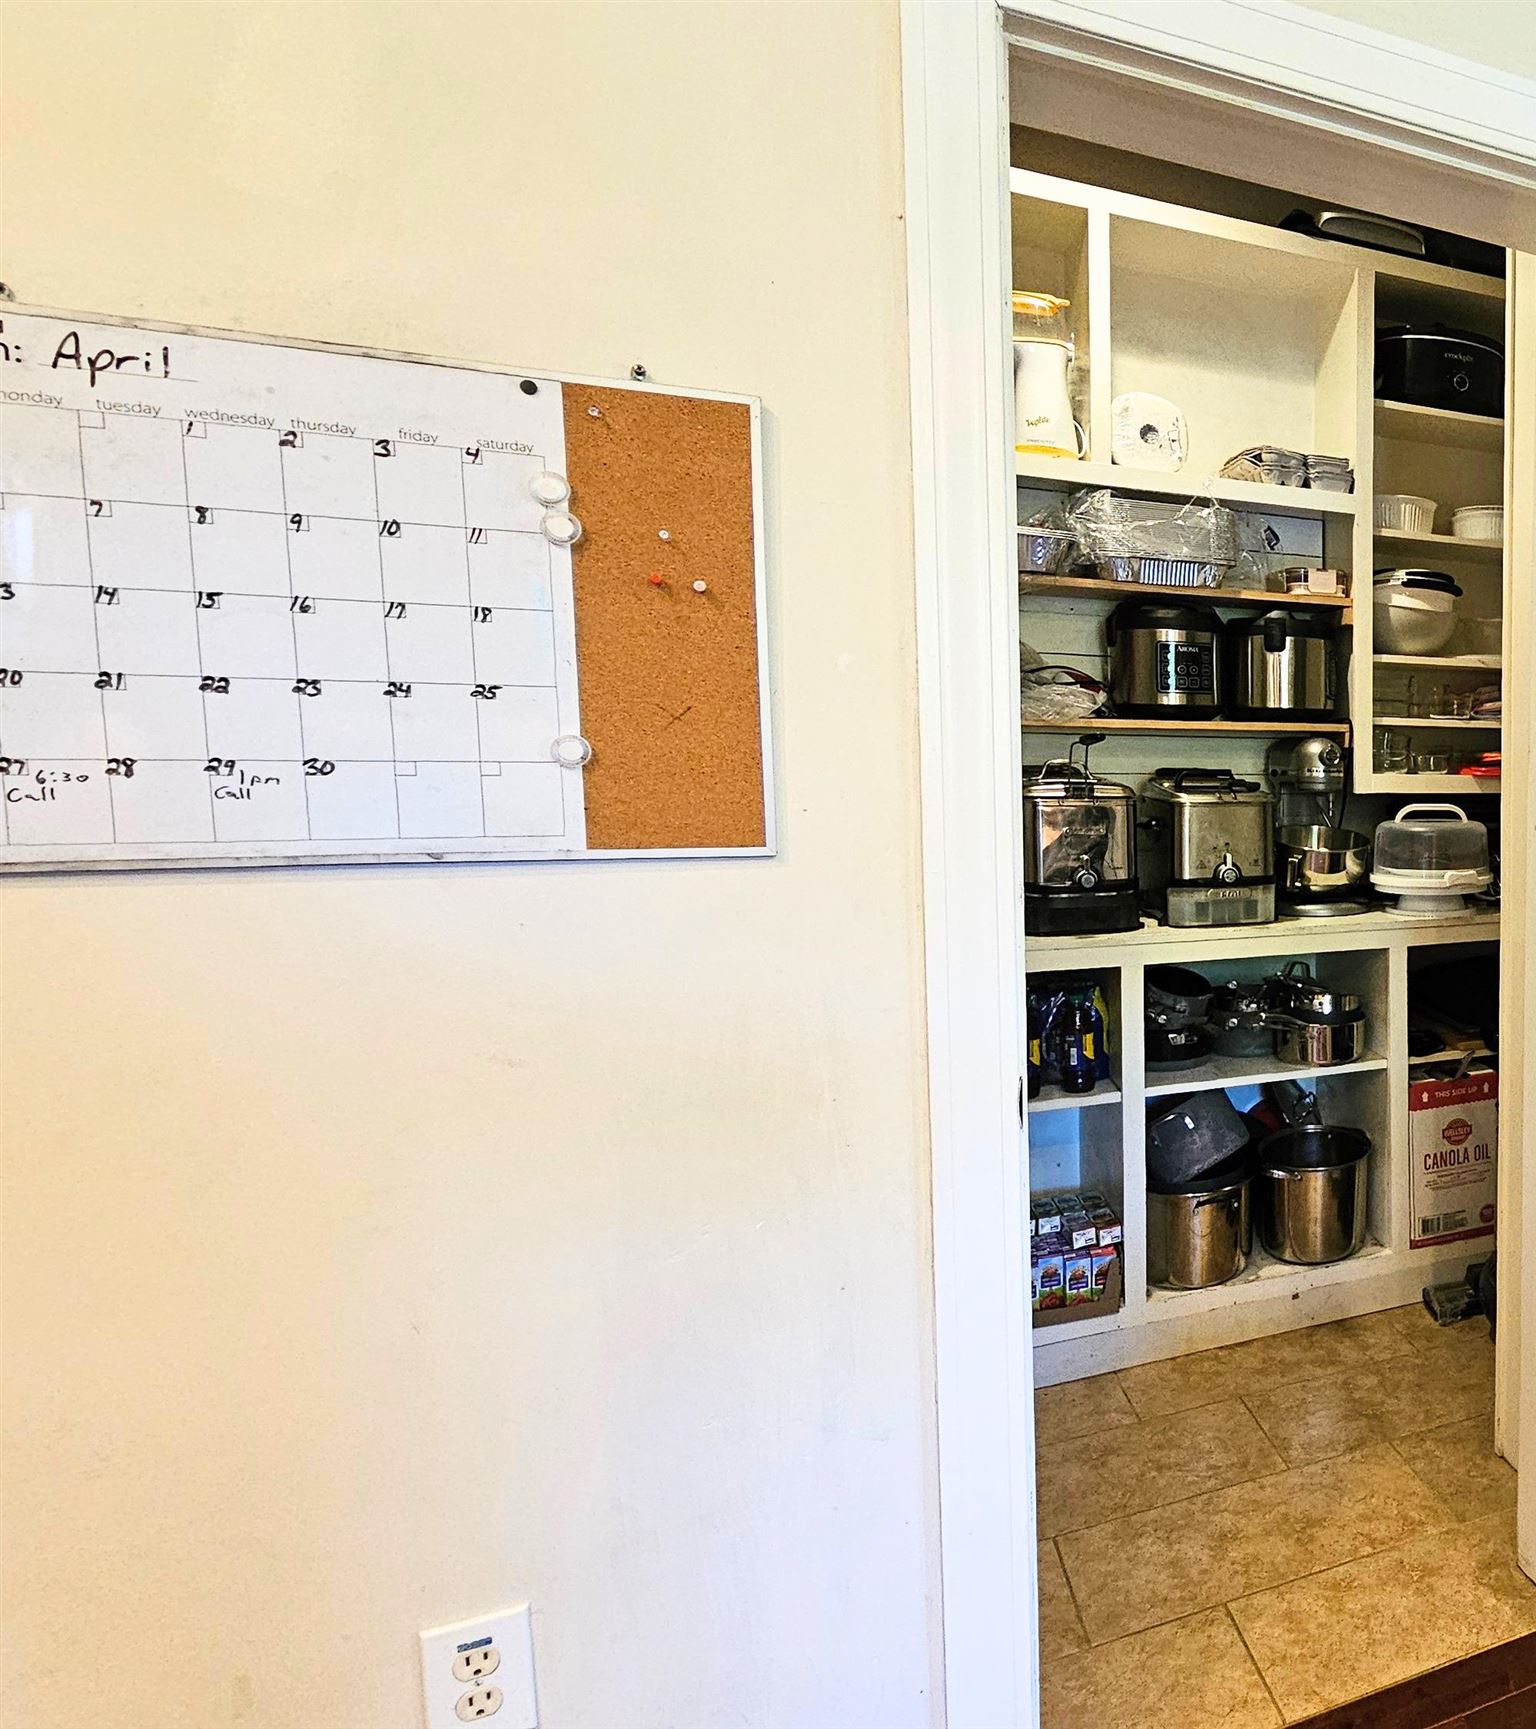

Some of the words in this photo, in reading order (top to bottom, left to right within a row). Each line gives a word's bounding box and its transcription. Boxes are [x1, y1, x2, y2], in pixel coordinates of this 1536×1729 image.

[51, 331, 171, 388] April
[97, 400, 162, 418] tuesday
[184, 408, 275, 429] wednesday
[290, 418, 357, 436] thursday
[398, 428, 439, 445] friday
[476, 437, 535, 454] saturday
[278, 430, 298, 448] 2
[374, 440, 391, 458] 3
[465, 446, 480, 464] 4
[89, 501, 103, 518] 7
[194, 506, 209, 525] 8
[289, 514, 302, 532] 9
[379, 519, 401, 536] 10
[468, 528, 483, 544] 11
[95, 585, 119, 605] 14
[196, 591, 223, 608] 15
[290, 596, 312, 613] 16
[473, 606, 492, 623] 18
[94, 671, 123, 690] 21
[199, 676, 230, 694] 22
[291, 679, 322, 696] 23
[383, 682, 412, 697] 24
[470, 684, 503, 699] 25
[0, 757, 25, 776] 27
[35, 769, 89, 785] 6:30
[105, 758, 138, 778] 28
[203, 758, 236, 776] 29
[304, 758, 336, 776] 30
[7, 786, 56, 803] Call
[214, 786, 252, 801] Call
[1423, 1147, 1471, 1171] CANOLA
[1473, 1143, 1492, 1162] OIL
